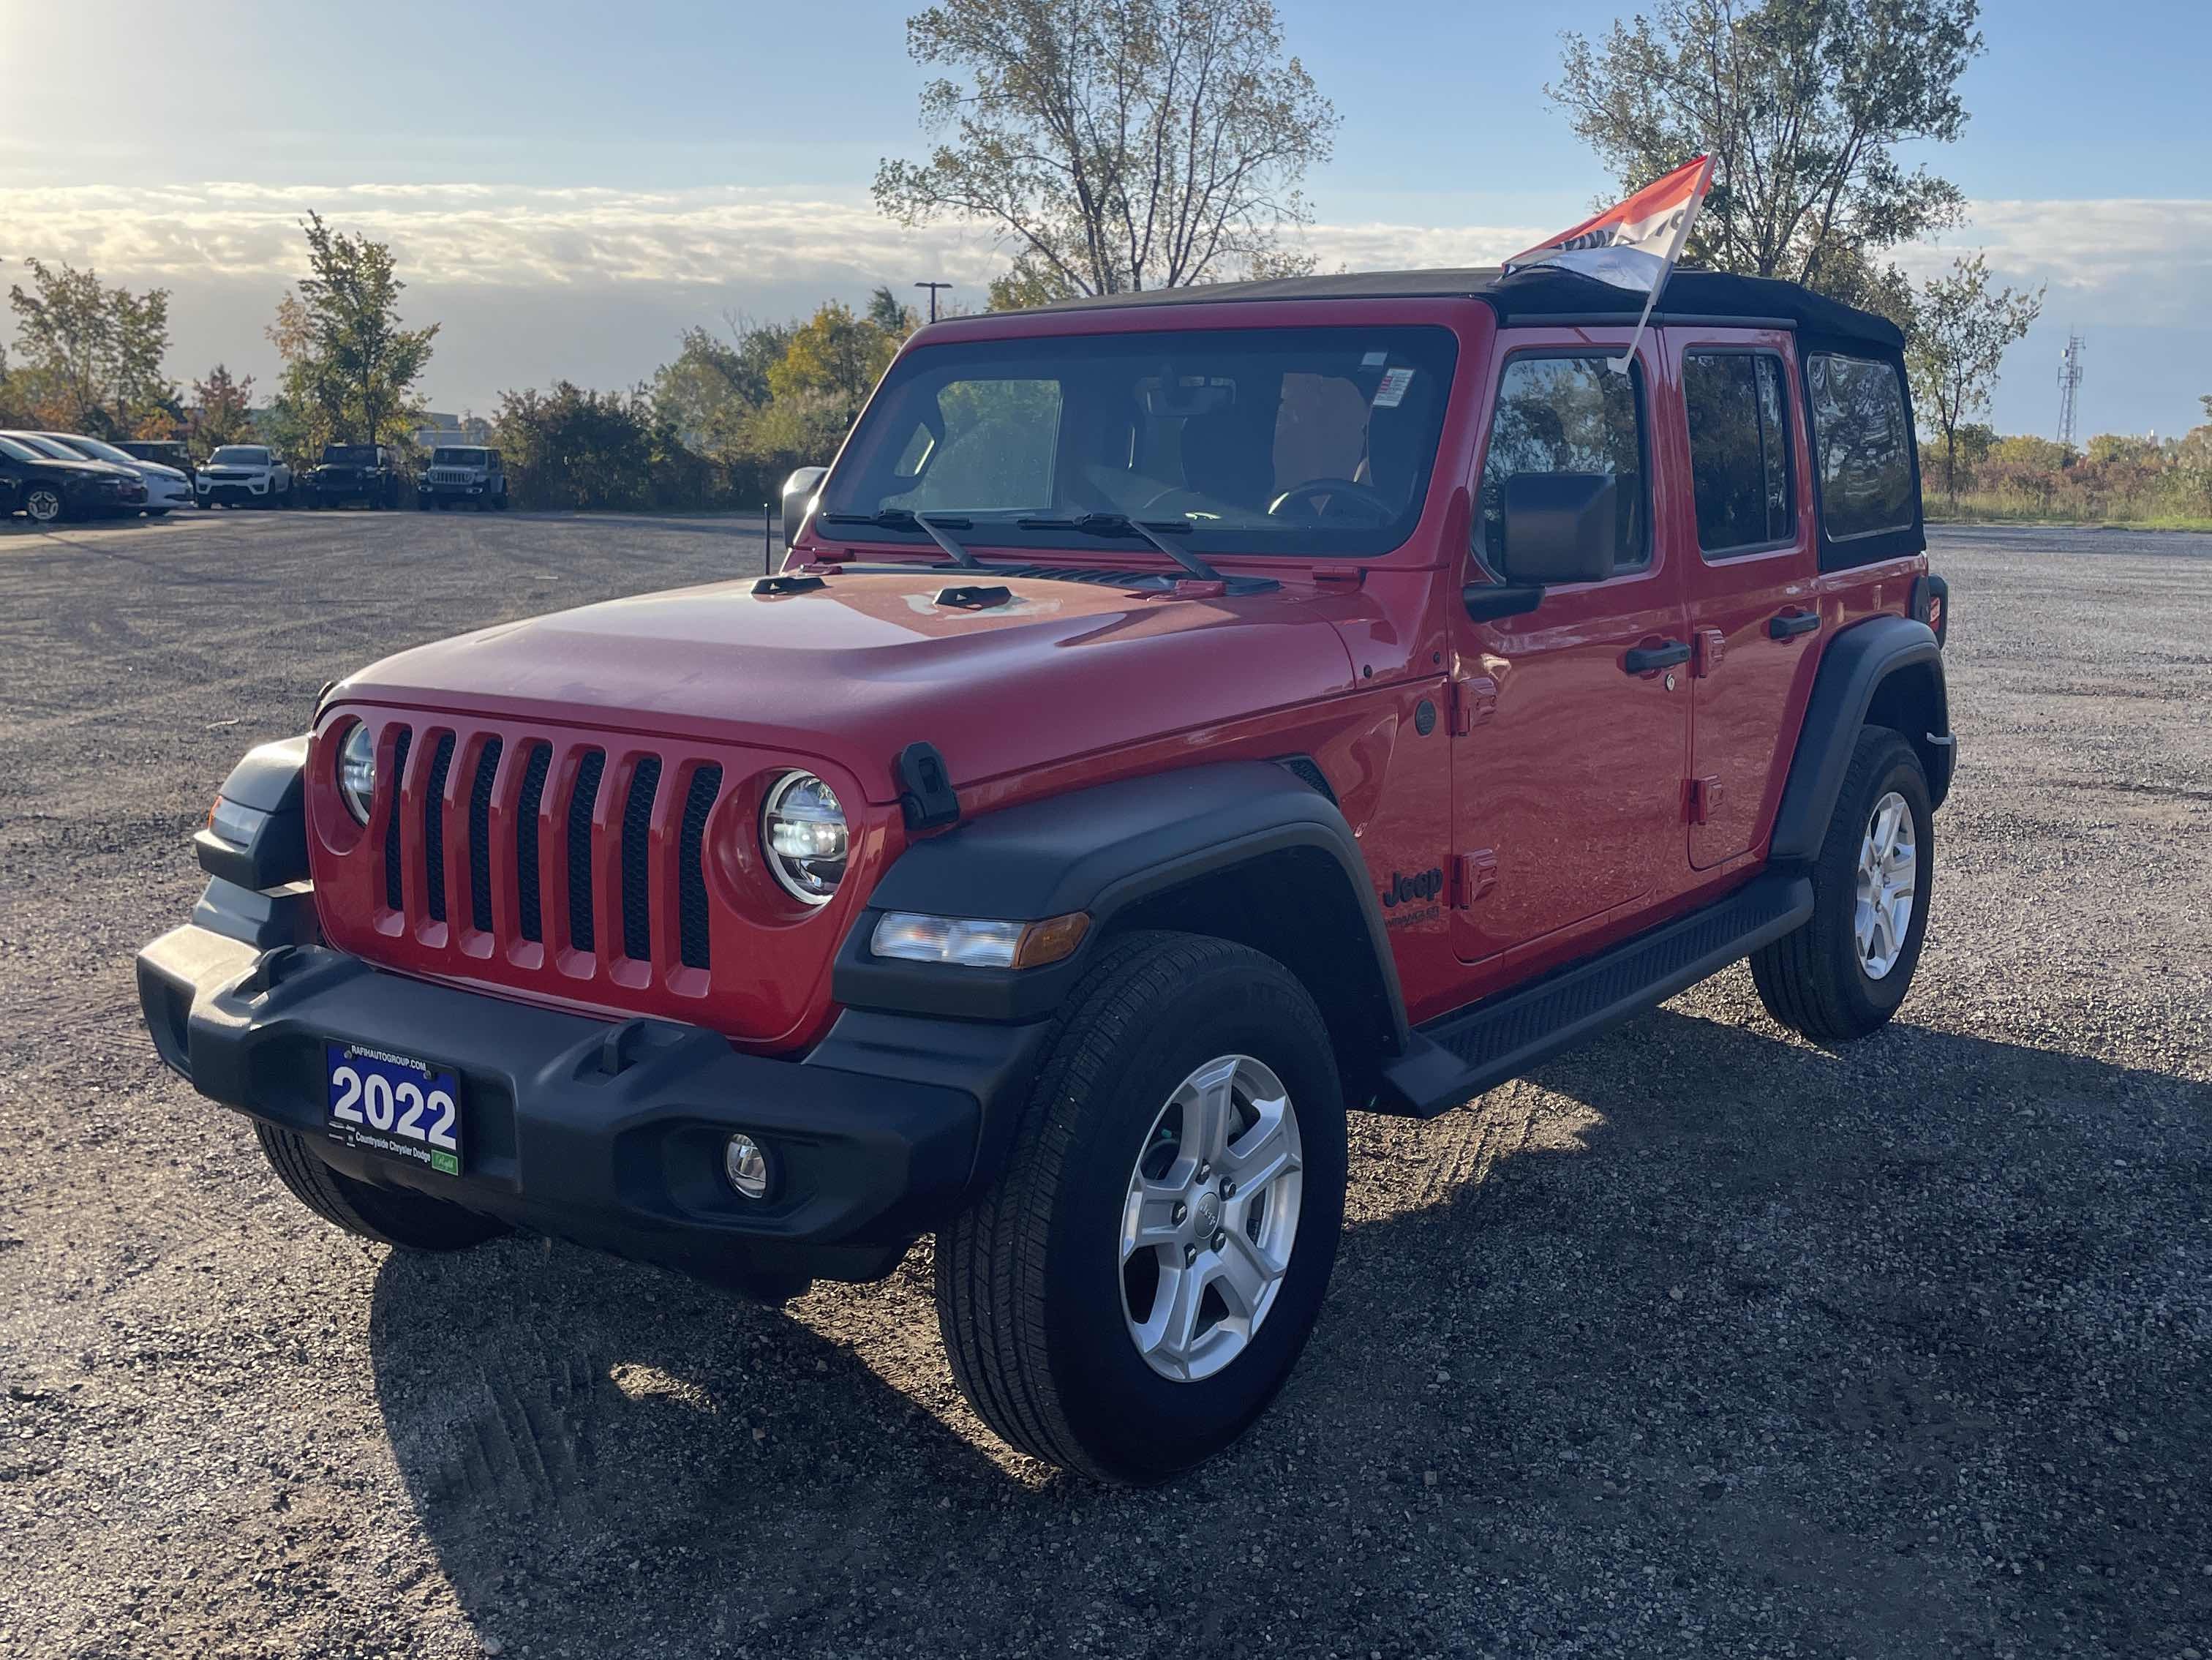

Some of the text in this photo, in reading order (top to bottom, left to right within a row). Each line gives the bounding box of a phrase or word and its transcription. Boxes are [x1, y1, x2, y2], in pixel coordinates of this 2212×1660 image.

[1382, 868, 1442, 907] Jeep
[351, 1045, 426, 1071] RAFIHAUTOGROUP.COM
[333, 1066, 456, 1150] 2022
[356, 1132, 388, 1149] Countryside
[389, 1141, 413, 1156] Chrysler
[413, 1146, 431, 1163] Dodge
